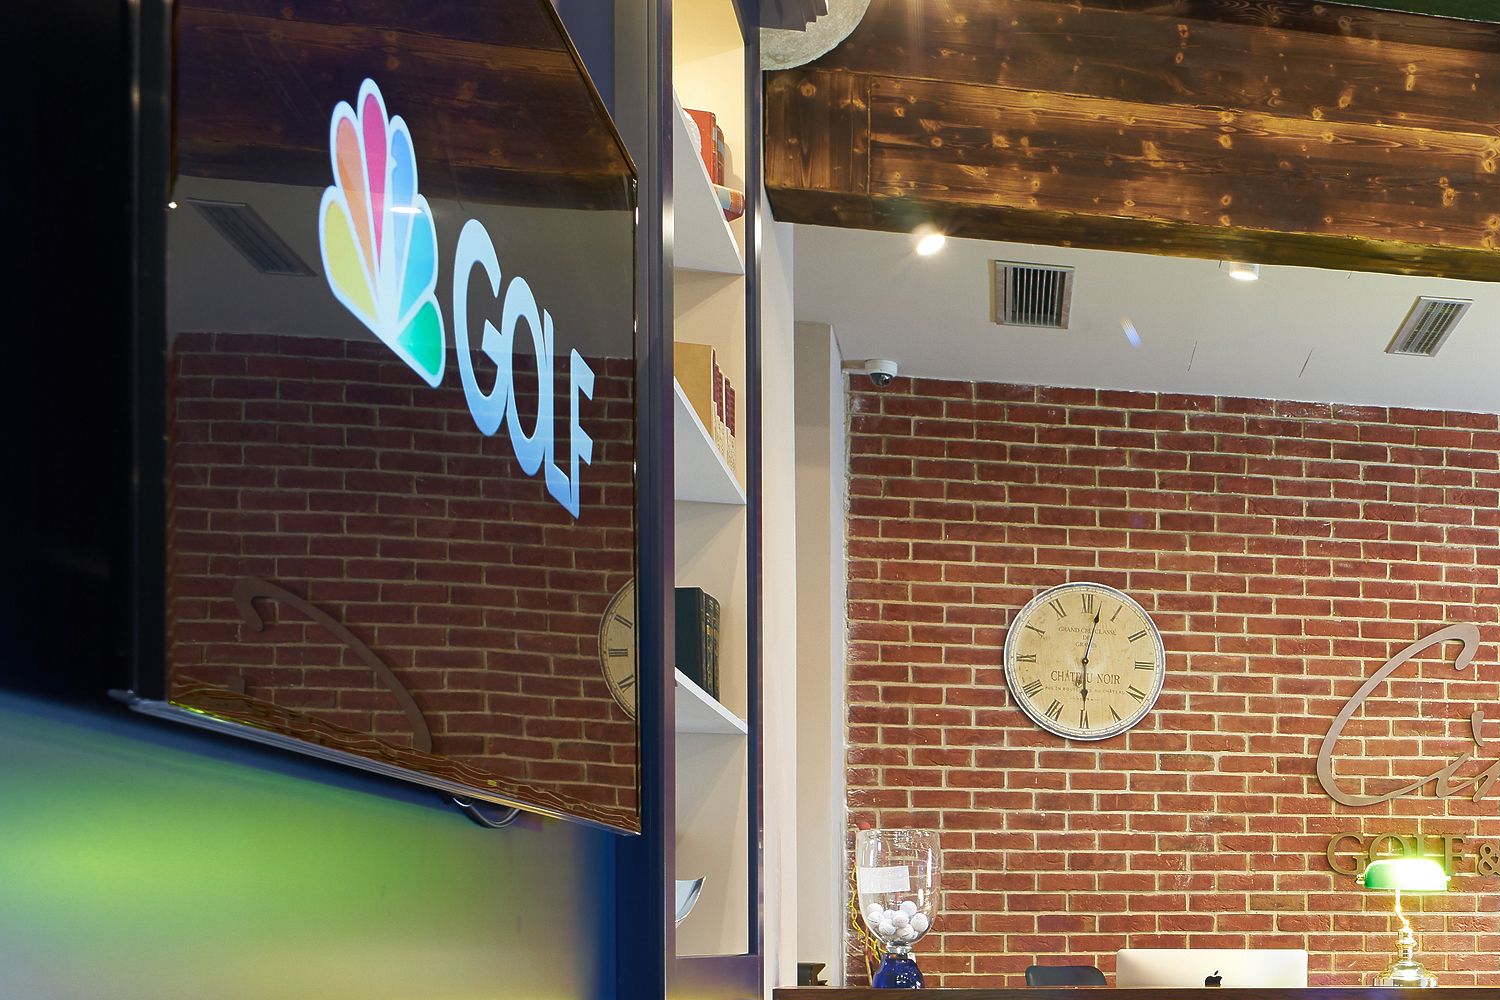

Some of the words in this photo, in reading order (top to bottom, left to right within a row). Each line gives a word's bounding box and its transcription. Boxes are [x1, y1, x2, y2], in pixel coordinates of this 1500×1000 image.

[453, 219, 595, 519] GOLF
[1081, 593, 1094, 614] XII
[1127, 629, 1148, 643] II
[1134, 661, 1155, 671] III
[1097, 673, 1121, 685] NOIR
